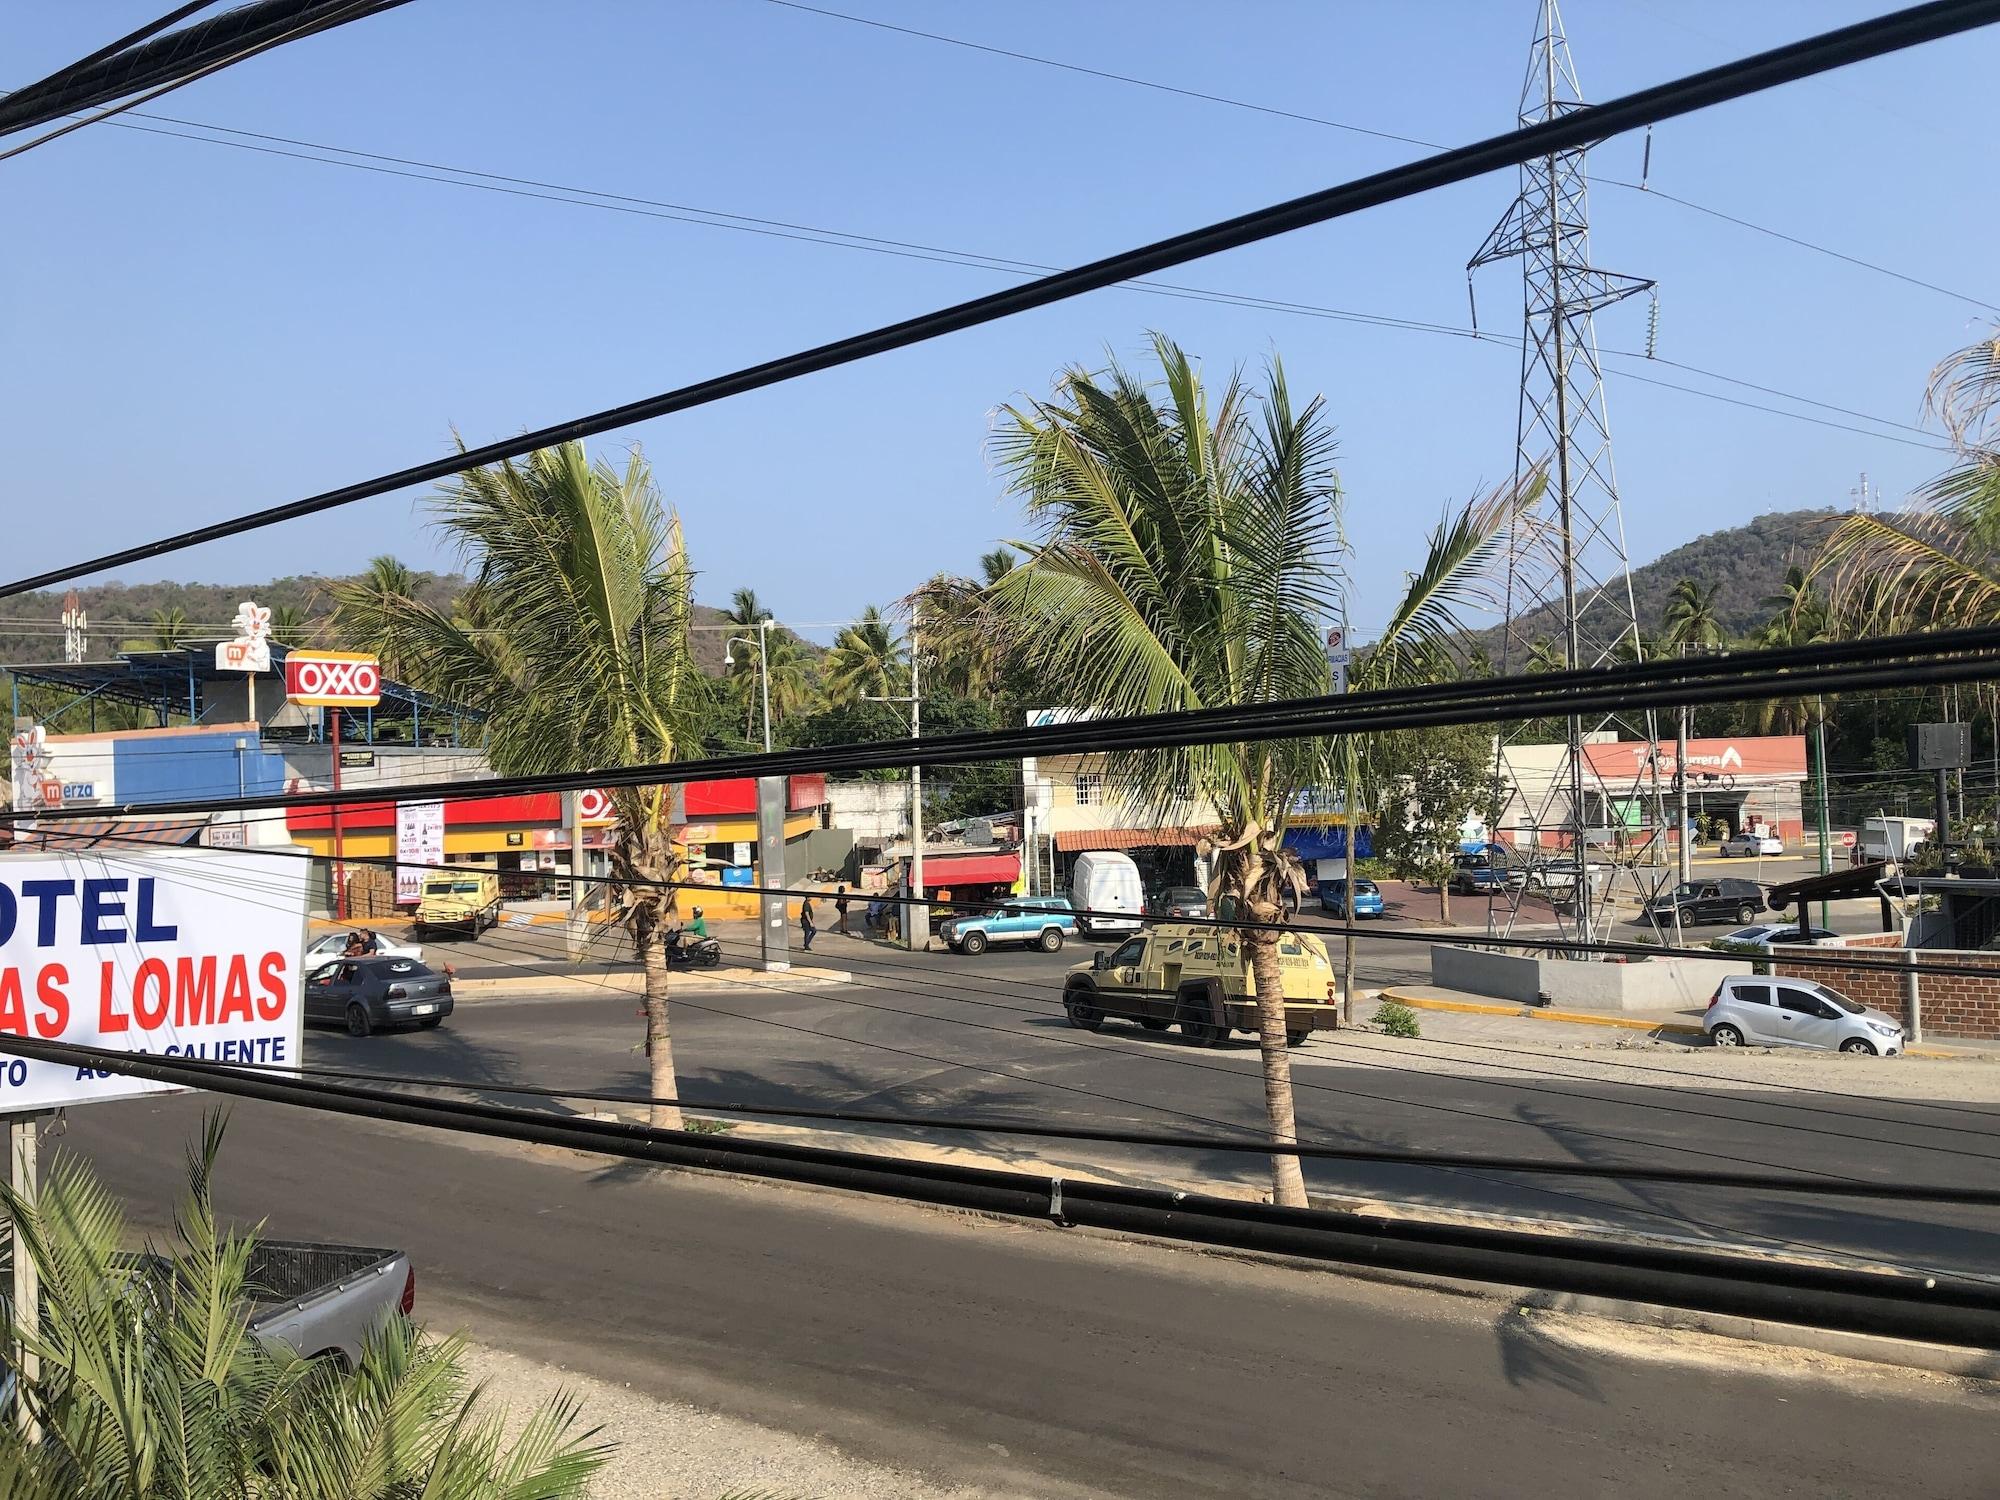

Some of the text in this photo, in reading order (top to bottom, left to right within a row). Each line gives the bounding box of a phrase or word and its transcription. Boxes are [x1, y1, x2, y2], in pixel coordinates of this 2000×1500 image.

[299, 663, 377, 695] OXXO
[1637, 755, 1721, 770] Bega urrera
[46, 783, 94, 799] merza
[0, 877, 178, 947] TEL
[99, 951, 287, 1033] LOMAS
